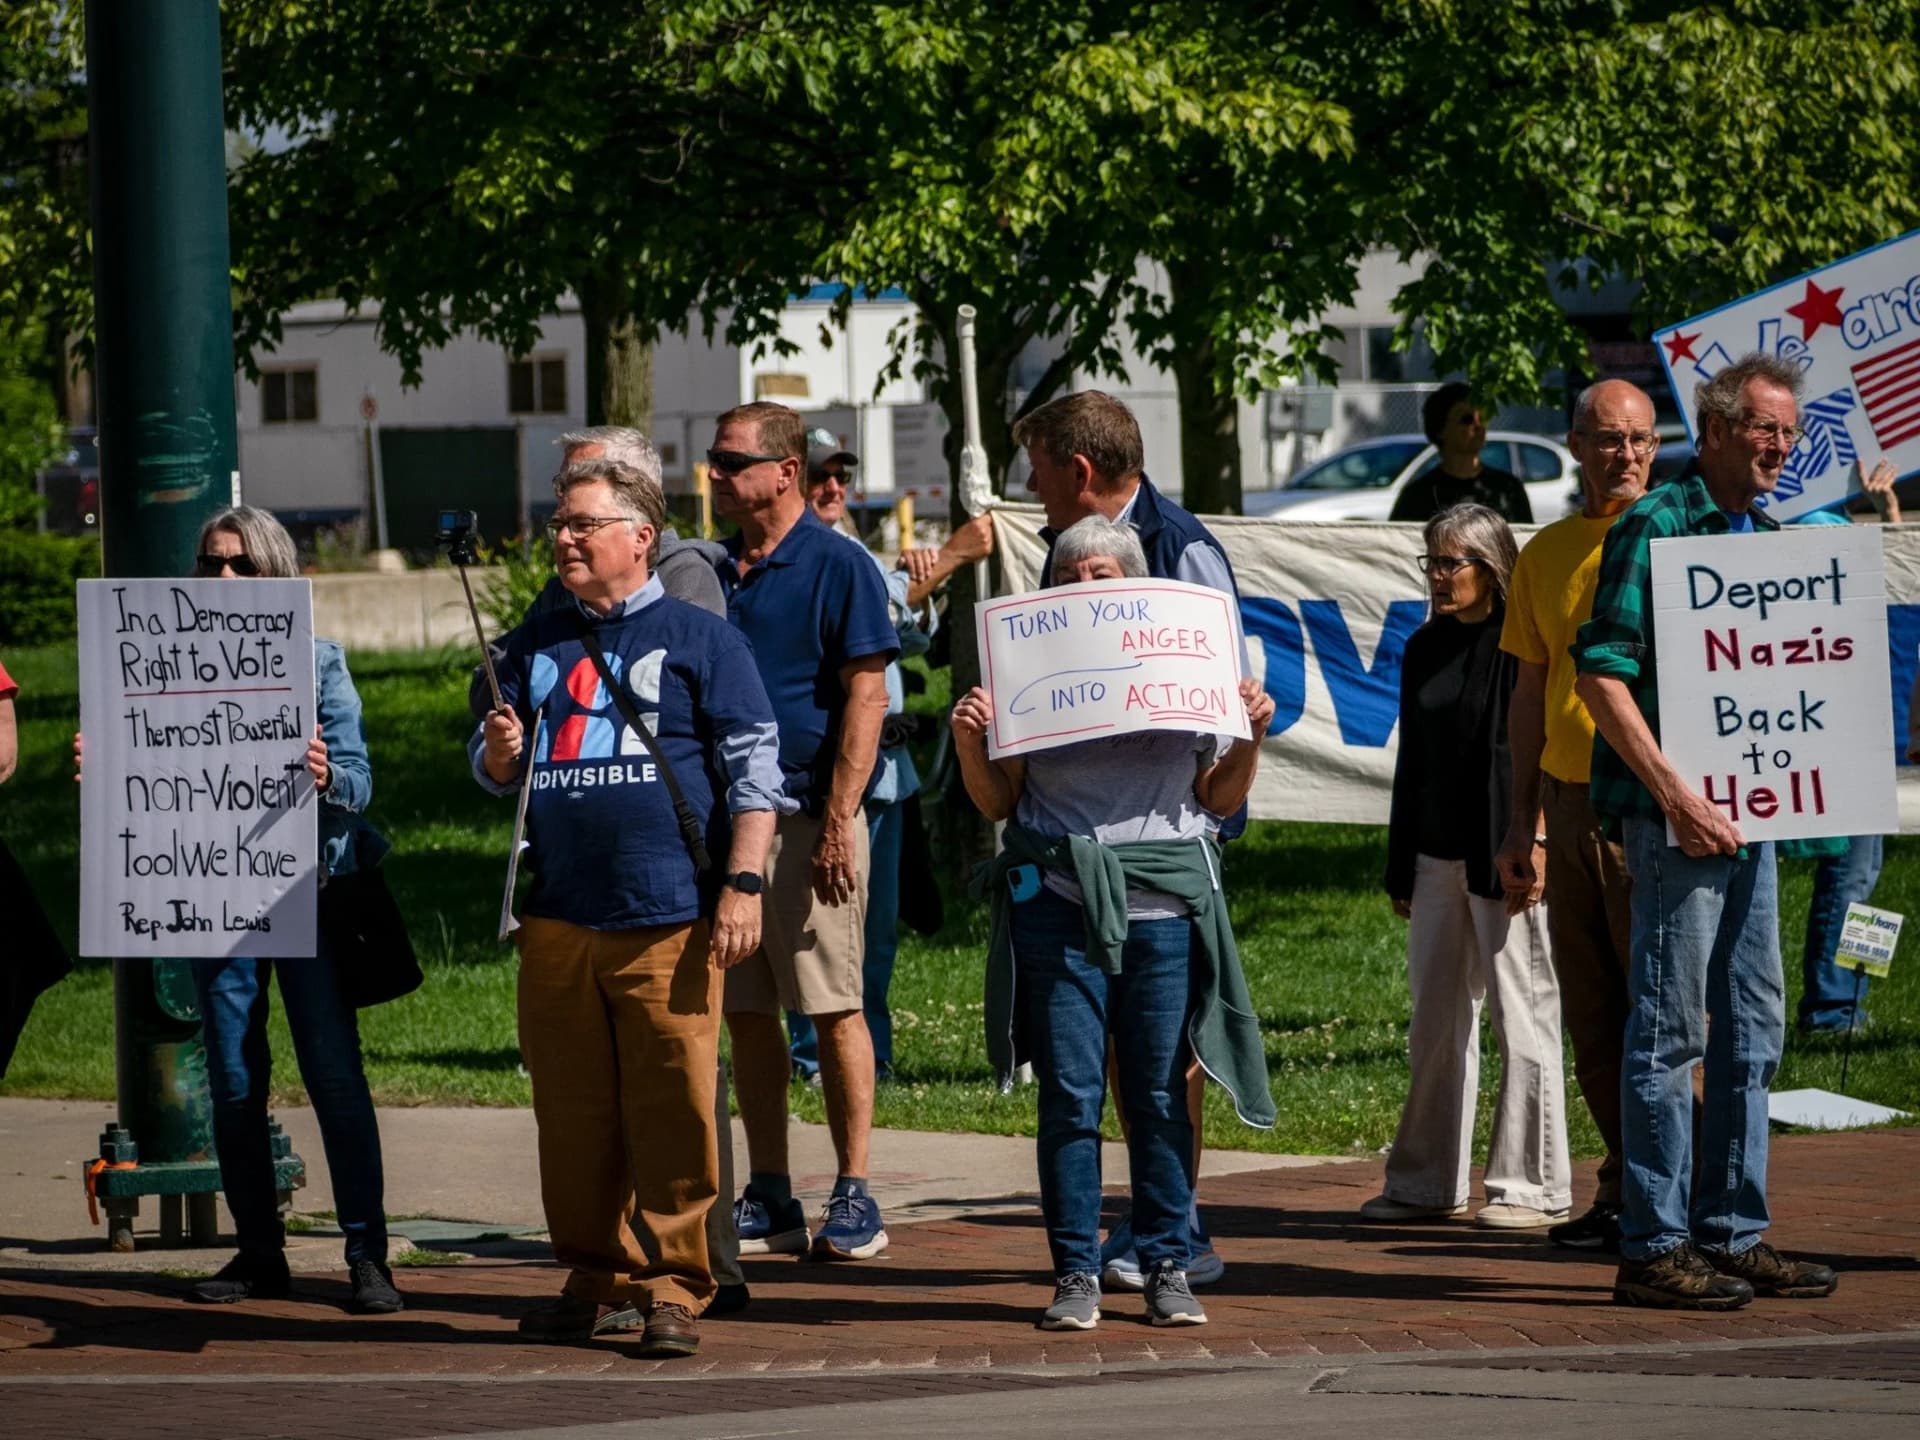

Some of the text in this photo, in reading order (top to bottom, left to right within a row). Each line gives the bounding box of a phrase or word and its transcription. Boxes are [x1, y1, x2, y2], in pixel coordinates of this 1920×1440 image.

[1686, 557, 1847, 620] Deport
[170, 586, 295, 640] Democracy
[1000, 597, 1156, 641] TURN YOUR
[119, 636, 287, 694] Right to Vote
[1120, 626, 1217, 658] ANGER
[1703, 626, 1855, 672] Nazis
[1050, 681, 1229, 717] INTO ACTION
[1713, 690, 1827, 737] Back
[218, 700, 303, 745] Powerful
[533, 762, 658, 791] NDIVISIBLE
[1742, 742, 1792, 775] to
[126, 759, 306, 813] non-Violent
[1703, 766, 1826, 822] Hell
[118, 824, 297, 879] tool We have
[119, 898, 272, 941] Rep. John Lewis
